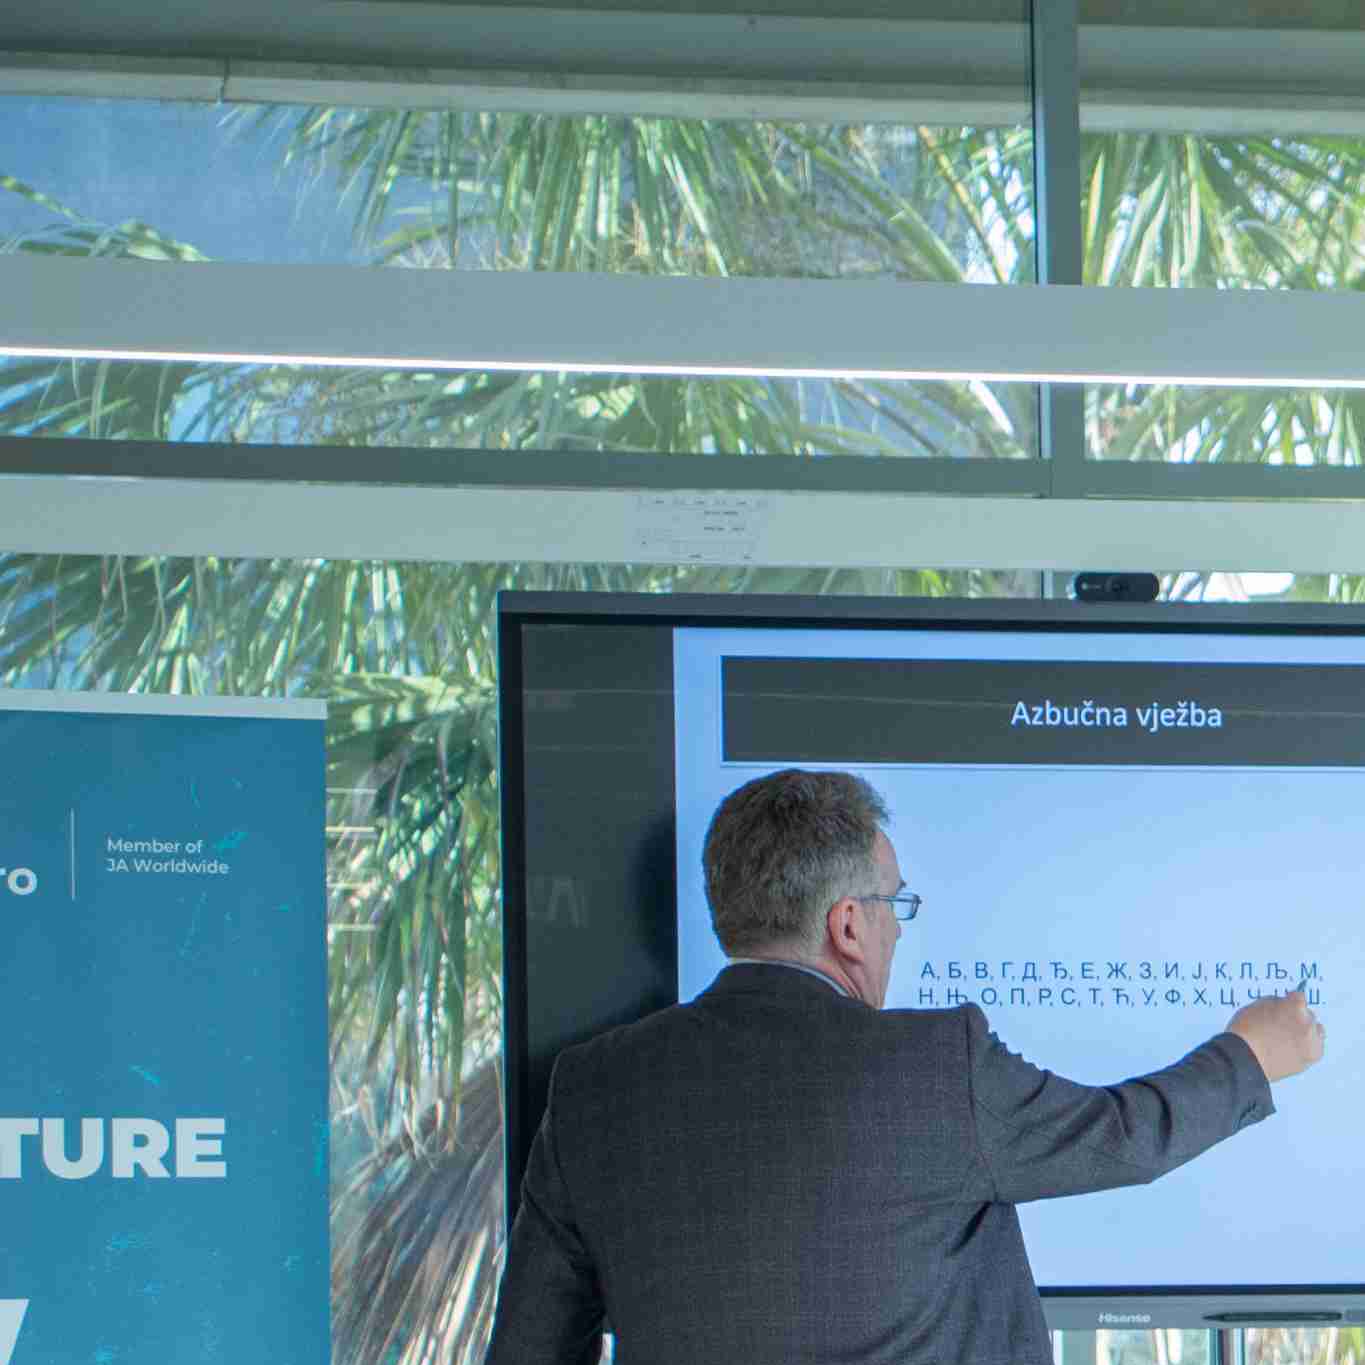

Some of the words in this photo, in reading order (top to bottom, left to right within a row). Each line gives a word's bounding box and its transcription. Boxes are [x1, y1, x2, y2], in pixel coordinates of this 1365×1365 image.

[1011, 700, 1127, 727] Azbučna
[1136, 700, 1222, 732] vježba
[107, 837, 181, 853] Member
[185, 839, 204, 854] of
[106, 858, 129, 873] JA
[134, 858, 230, 874] Worldwide
[0, 1117, 227, 1180] TURE
[1099, 1313, 1151, 1323] Hisense
